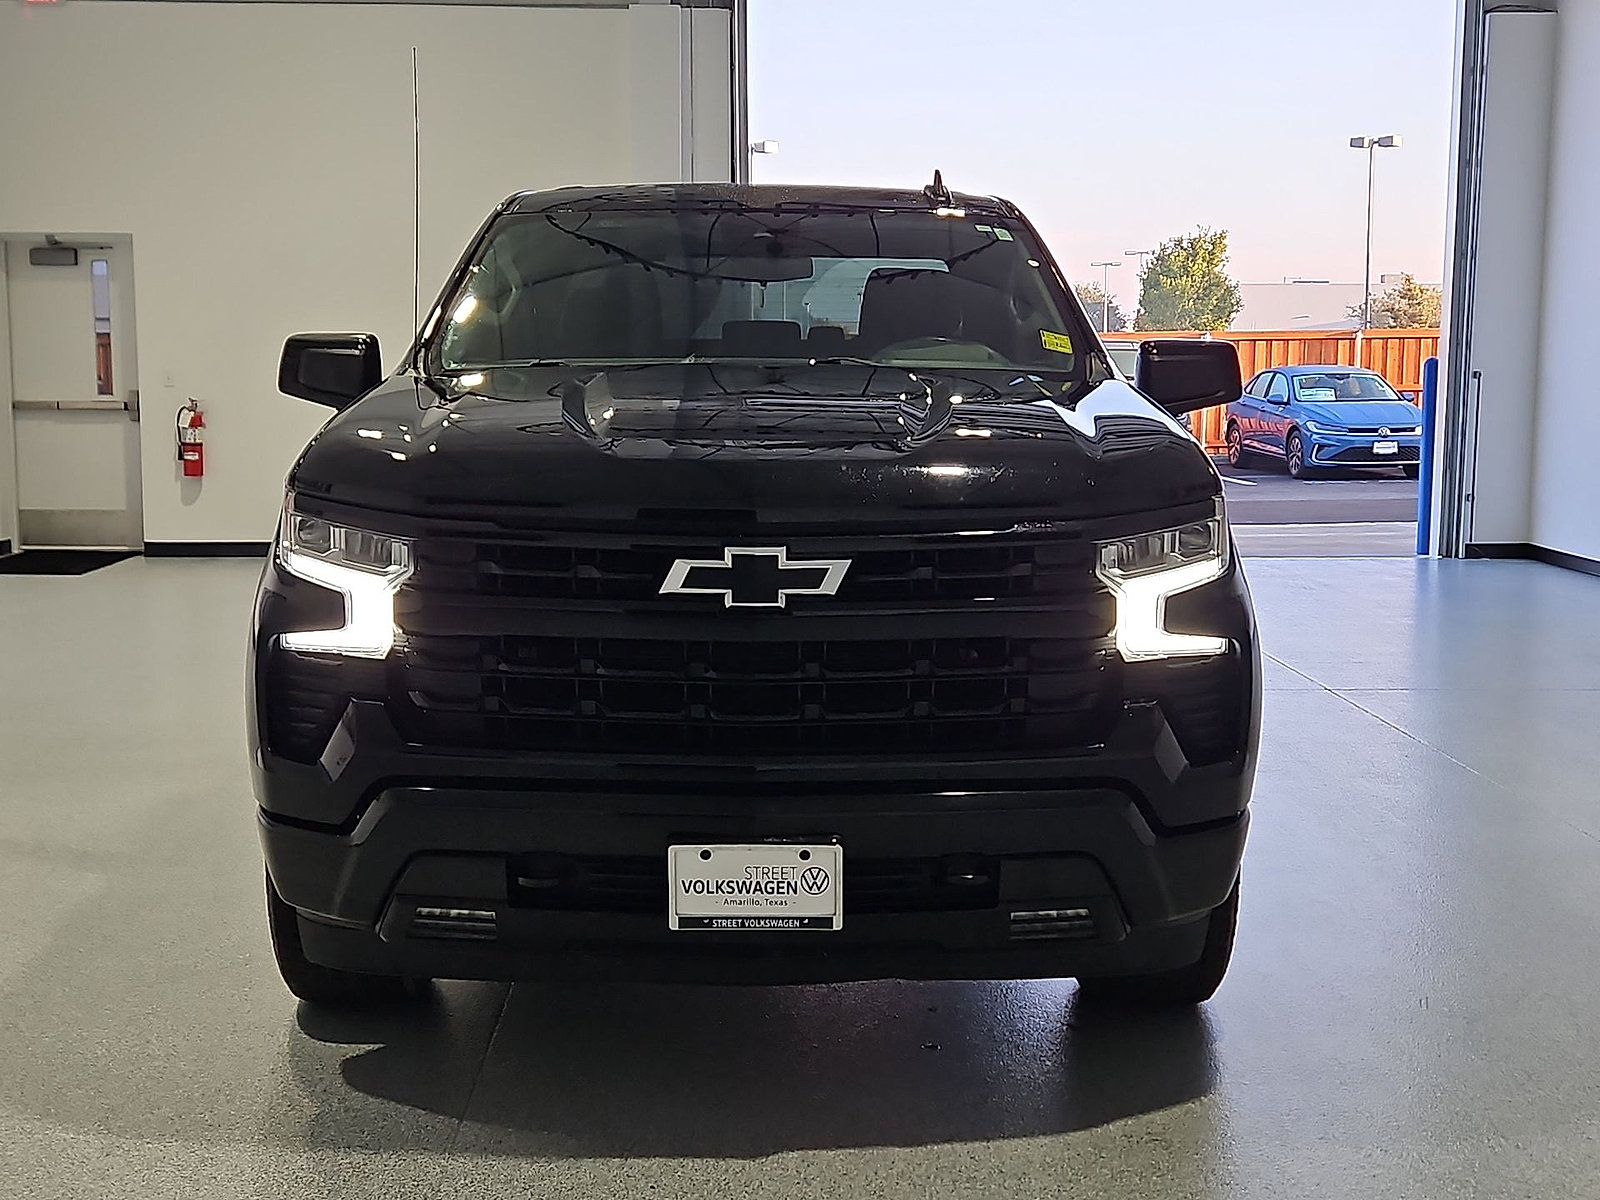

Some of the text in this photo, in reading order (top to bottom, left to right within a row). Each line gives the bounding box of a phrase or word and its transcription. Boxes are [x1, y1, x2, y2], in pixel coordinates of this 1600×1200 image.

[744, 866, 797, 880] STREET
[681, 880, 797, 895] VOLKSWAGEN
[723, 898, 788, 907] Amarillo, Texas
[712, 919, 800, 928] STREET VOLKSWAGEN
